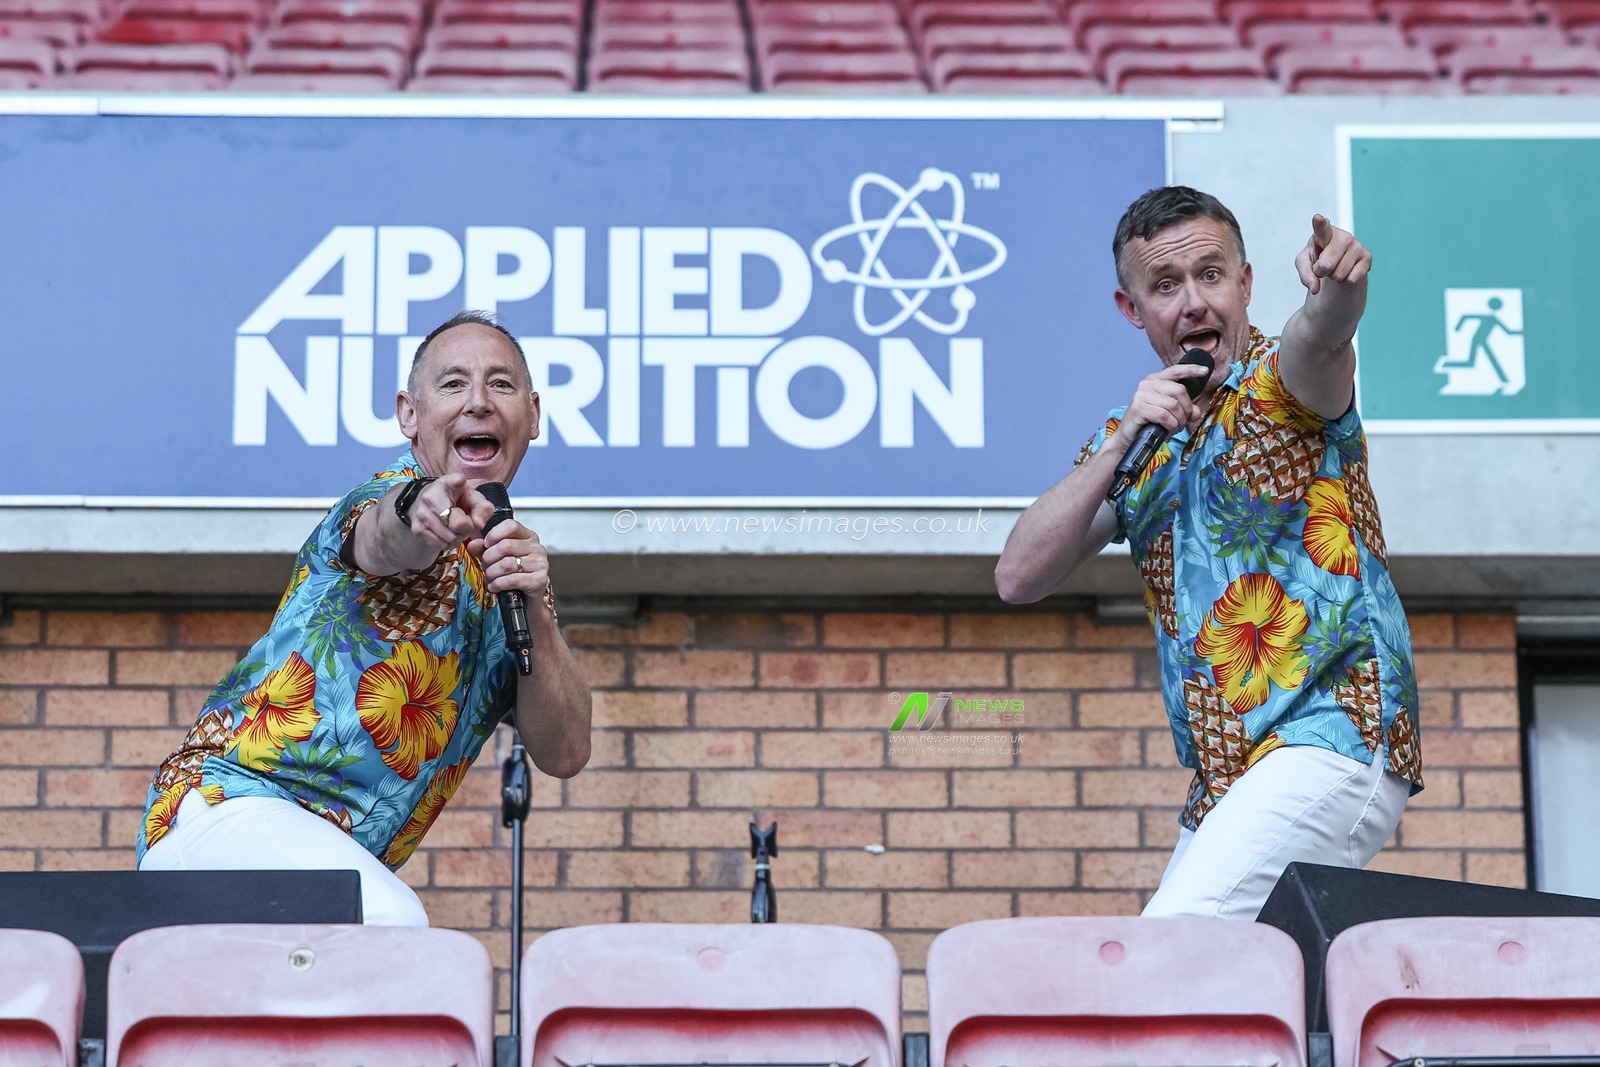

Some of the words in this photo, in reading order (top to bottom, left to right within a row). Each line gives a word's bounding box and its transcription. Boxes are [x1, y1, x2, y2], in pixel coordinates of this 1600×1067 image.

[971, 172, 1000, 190] TM
[236, 225, 813, 336] APPLIED
[232, 335, 985, 450] NURITION
